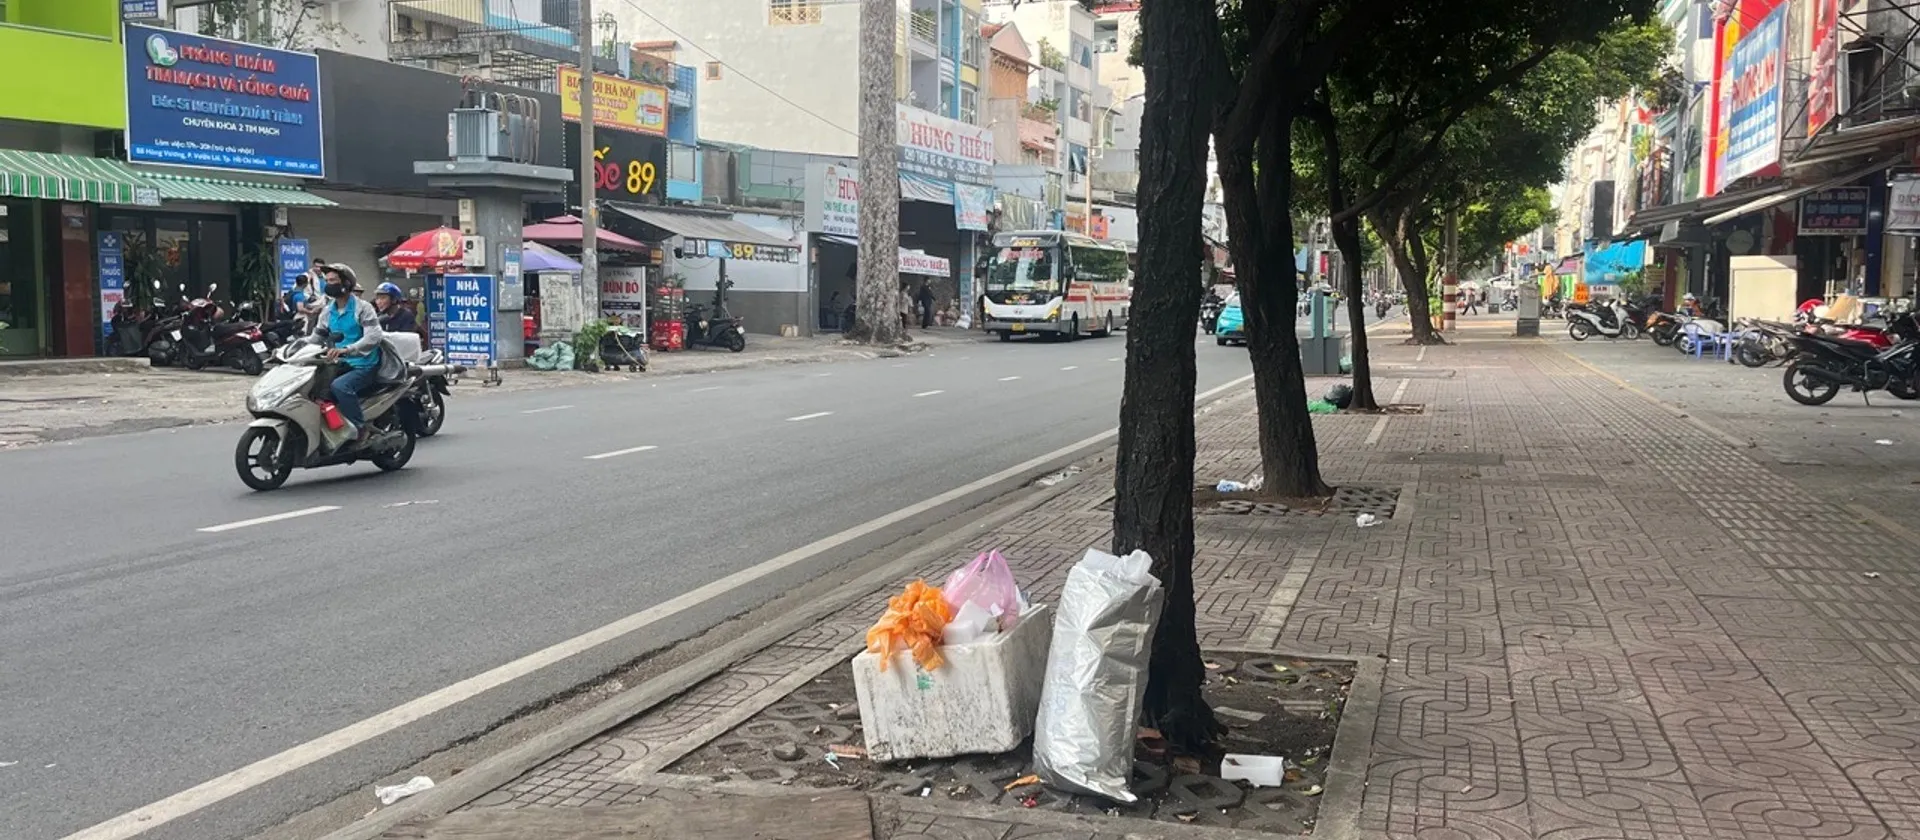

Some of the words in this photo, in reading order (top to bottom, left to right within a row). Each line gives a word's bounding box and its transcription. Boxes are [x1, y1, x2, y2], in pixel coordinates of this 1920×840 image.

[180, 43, 233, 66] PHÒNG
[235, 52, 276, 74] KHÁM
[145, 65, 173, 83] TIM
[173, 70, 217, 91] MẠCH
[219, 73, 237, 92] VÀ
[279, 83, 312, 103] QUÁT
[182, 116, 215, 129] CHUYÊN
[216, 120, 237, 132] KHOA
[238, 123, 244, 132] 2
[245, 124, 258, 134] TIM
[258, 126, 280, 137] MẠCH
[911, 117, 955, 154] HÙNG
[626, 160, 656, 195] 89
[282, 242, 305, 256] PHÒNG
[733, 243, 755, 258] 89
[284, 259, 304, 270] KHÁM
[456, 278, 480, 291] NHÀ
[625, 279, 639, 294] BÒ
[450, 293, 487, 307] THUỐC
[458, 308, 479, 321] TÂY
[448, 331, 470, 343] PHÒNG
[471, 332, 490, 343] KHÁM
